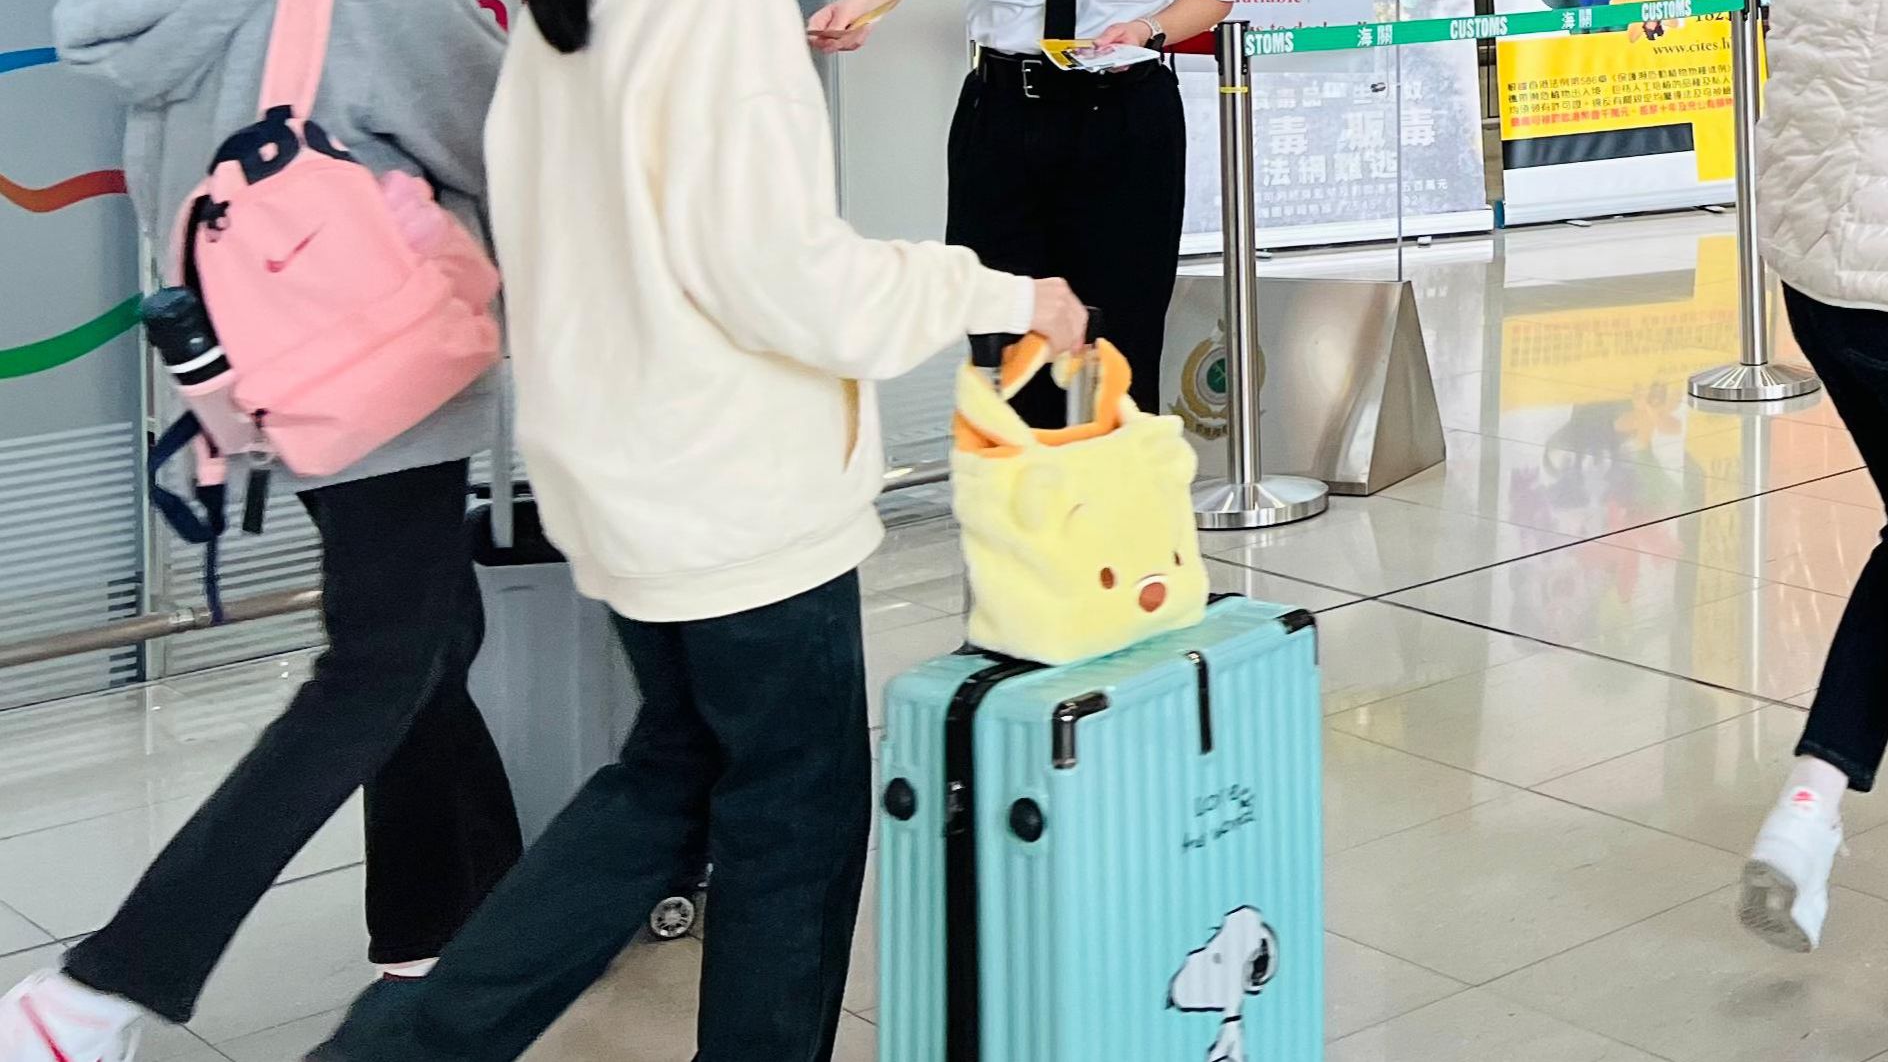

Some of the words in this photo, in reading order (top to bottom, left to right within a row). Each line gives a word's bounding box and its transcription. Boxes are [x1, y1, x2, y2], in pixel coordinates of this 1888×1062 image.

[1450, 16, 1508, 39] CUSTOMS
[1245, 31, 1294, 57] STOMS
[1653, 37, 1731, 55] www.cites.h
